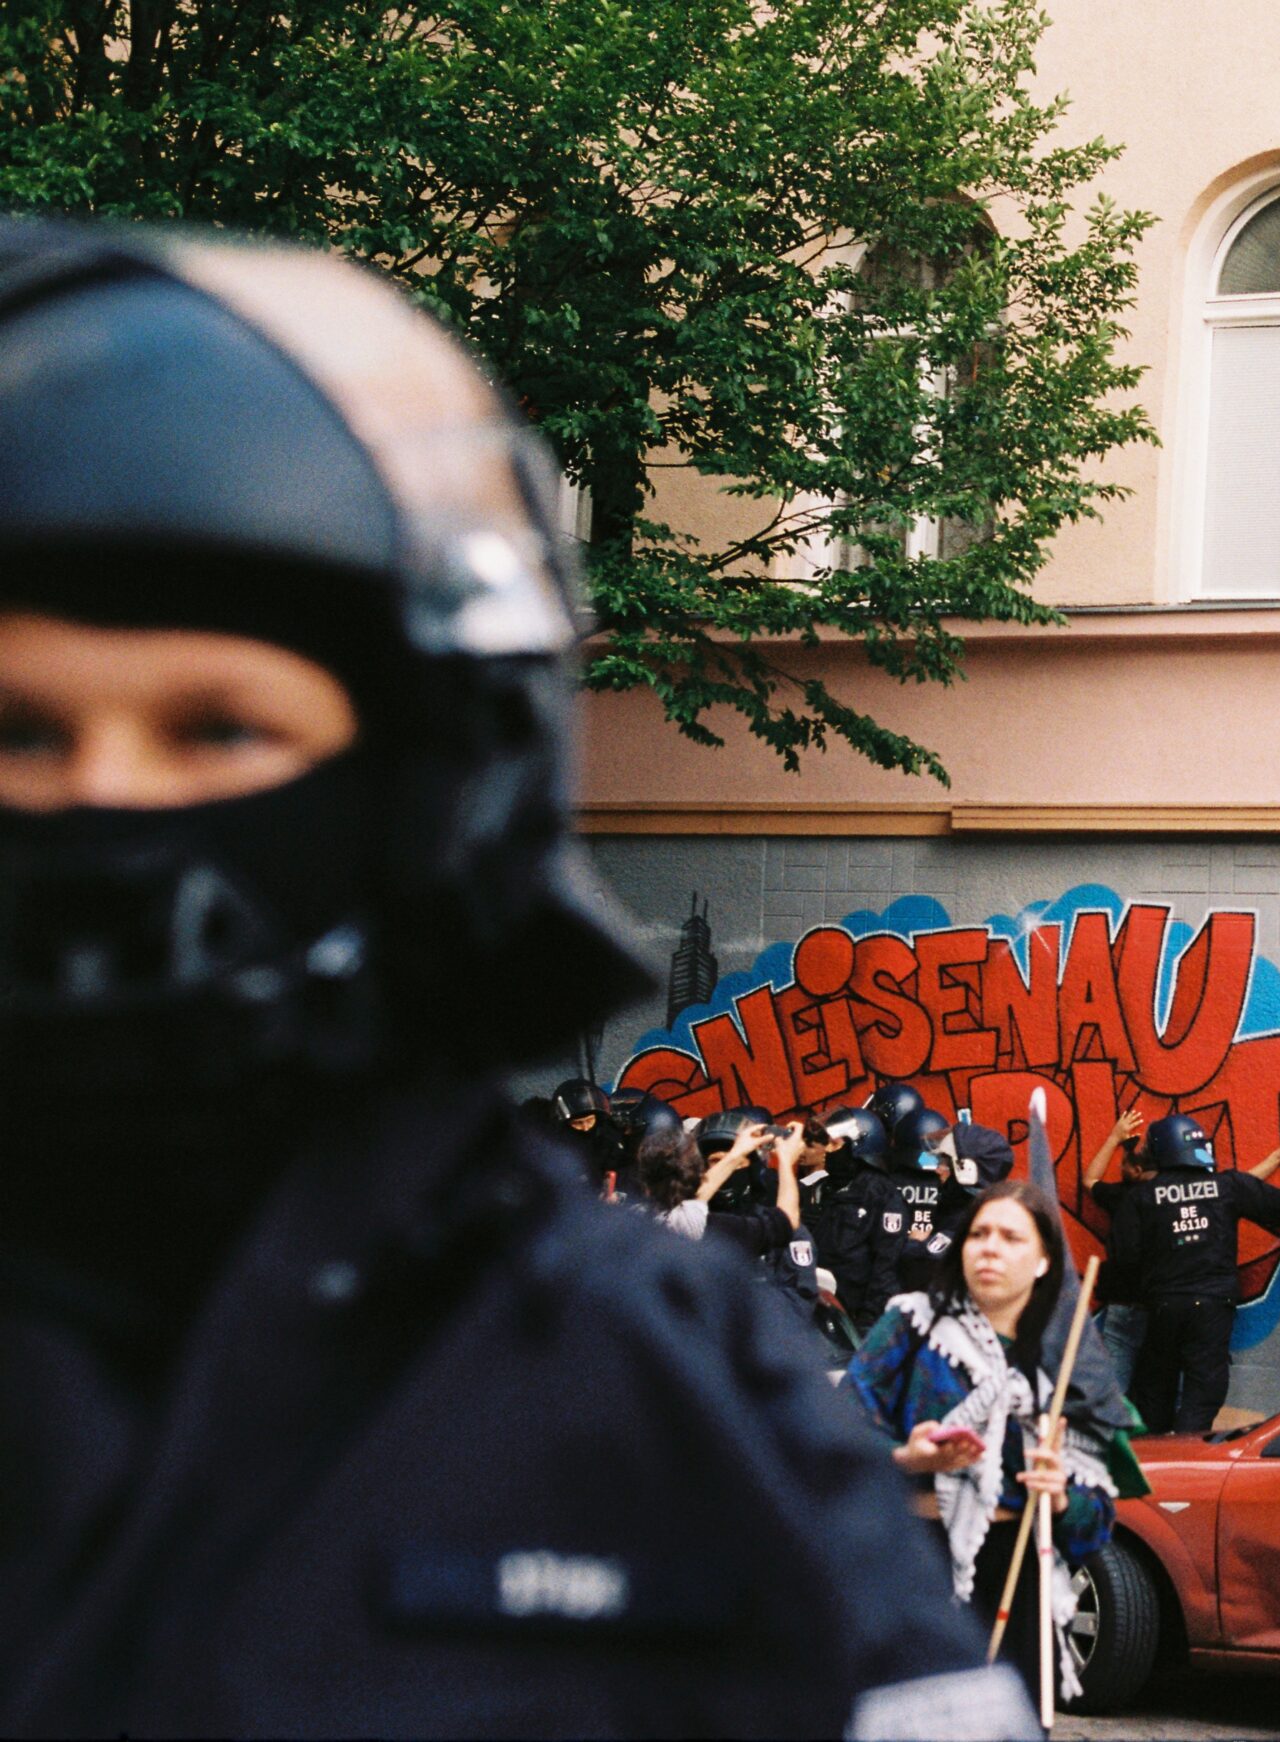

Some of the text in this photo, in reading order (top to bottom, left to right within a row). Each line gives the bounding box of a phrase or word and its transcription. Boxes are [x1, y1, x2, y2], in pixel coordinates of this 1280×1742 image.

[1154, 1181, 1219, 1204] POLIZEI
[914, 1210, 932, 1223] BE
[1180, 1206, 1198, 1219] BE
[1172, 1217, 1209, 1233] 16110
